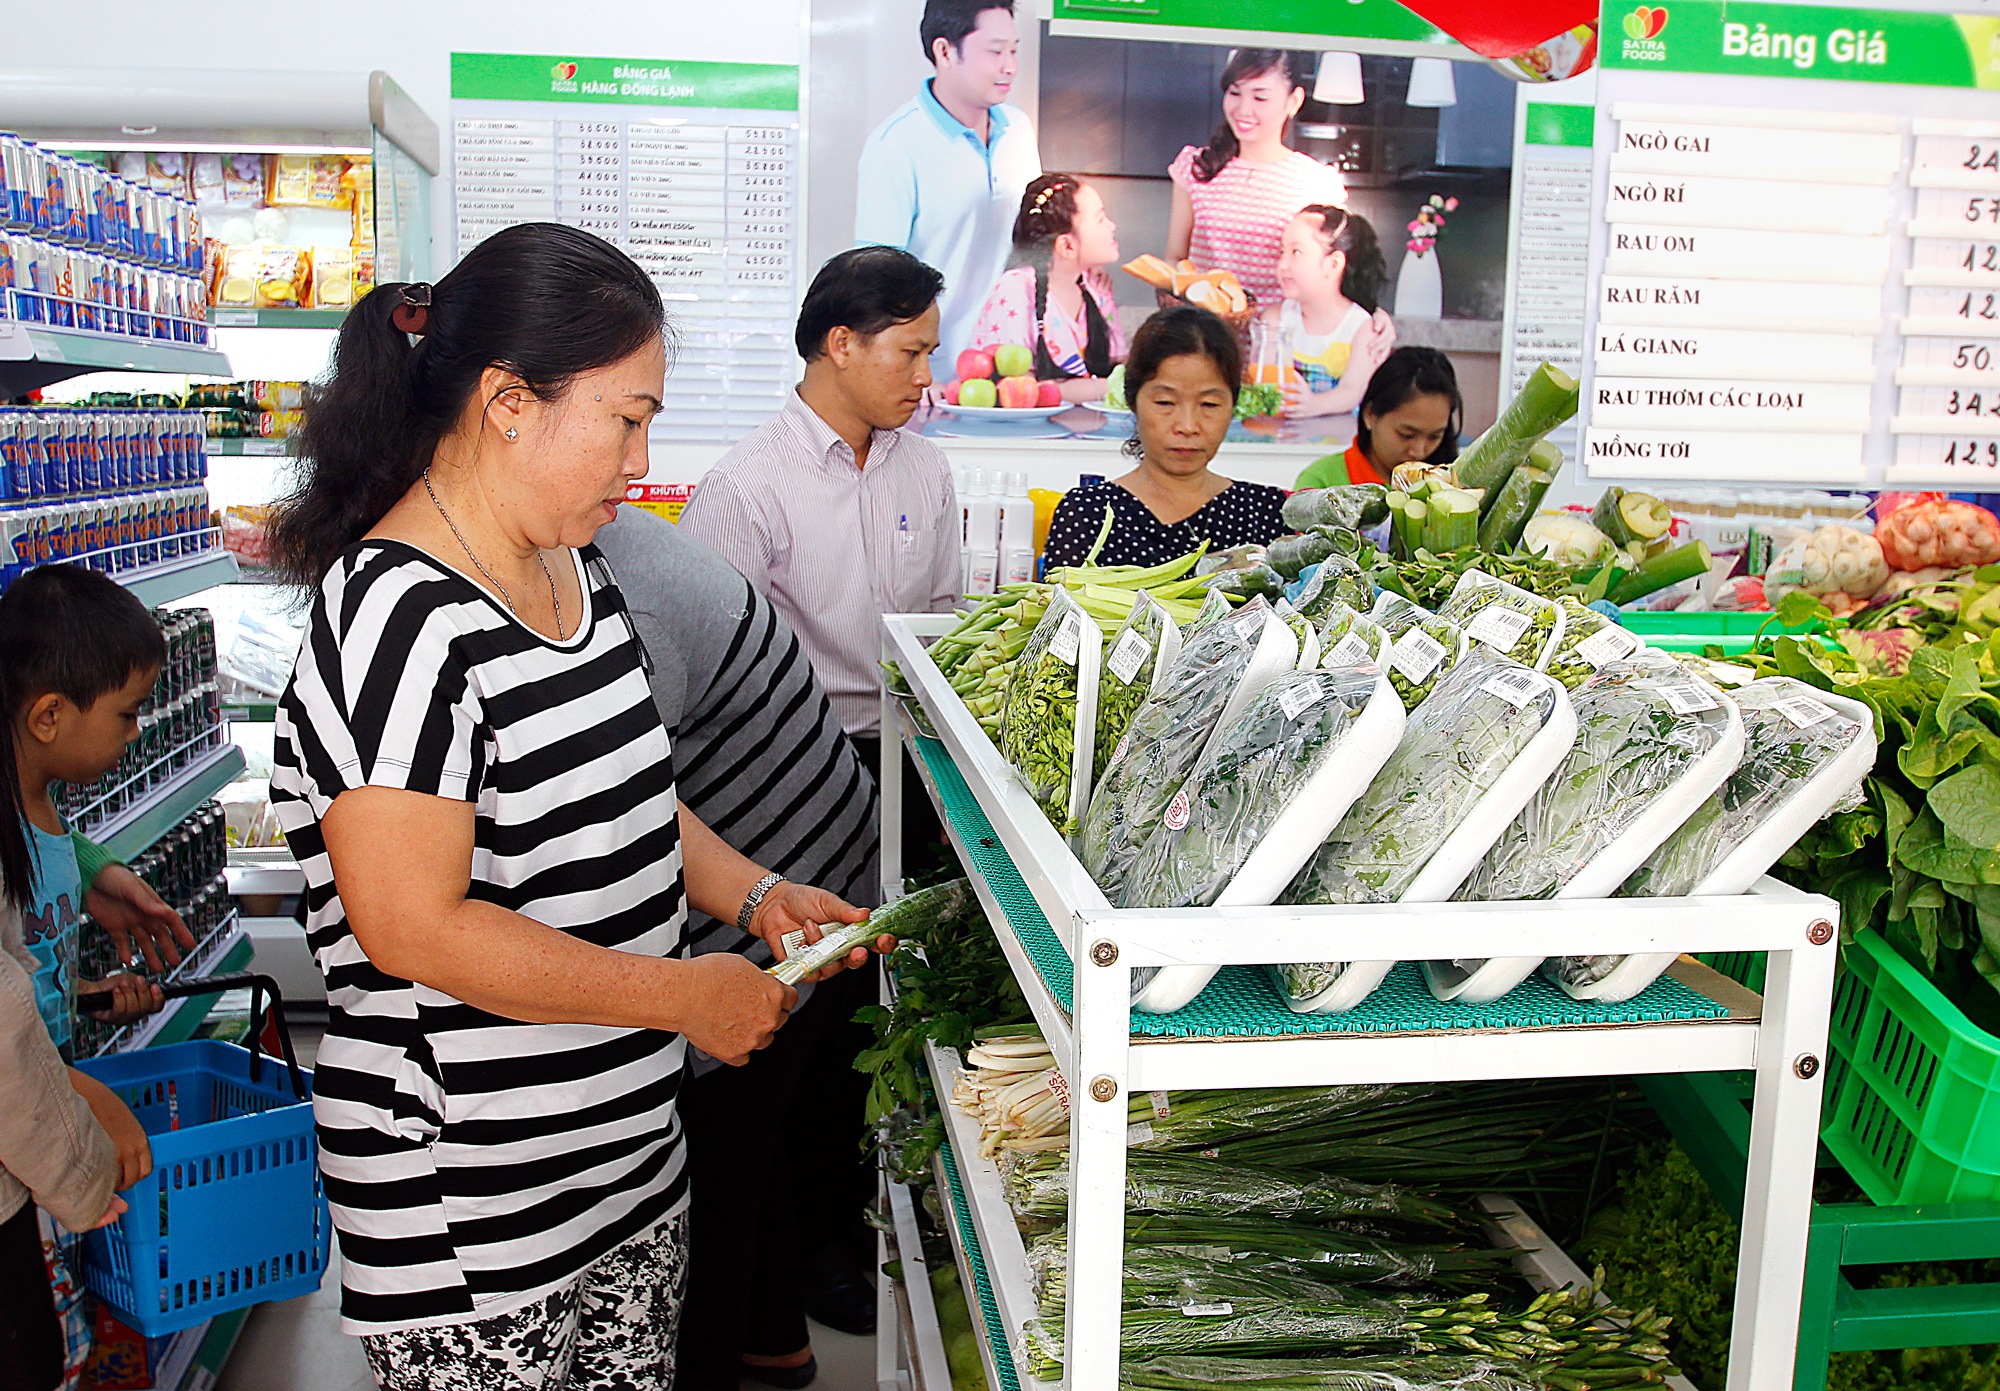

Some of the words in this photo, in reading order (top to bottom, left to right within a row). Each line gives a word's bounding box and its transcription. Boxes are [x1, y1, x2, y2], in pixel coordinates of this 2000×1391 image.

[1623, 39, 1665, 51] SATRA
[1623, 50, 1665, 61] FOODS
[1721, 21, 1816, 69] Bảng
[1827, 29, 1887, 65] Giá
[581, 81, 618, 95] HÀNG
[1624, 131, 1668, 150] NGÒ
[1674, 136, 1711, 153] GAI
[1614, 182, 1657, 202] NGÒ
[1663, 183, 1685, 203] RÍ
[1616, 234, 1658, 251] RAU
[1663, 236, 1695, 252] OM
[1607, 287, 1648, 304] RAU
[1654, 285, 1700, 305] RĂM
[1600, 333, 1626, 353] LÁ
[1633, 338, 1698, 355] GIANG
[1598, 389, 1640, 406] RAU
[1645, 388, 1704, 407] THƠM
[1709, 388, 1752, 408] CÁC
[1756, 392, 1804, 411] LOẠI
[1591, 434, 1651, 458] MỒNG
[1657, 441, 1690, 458] TƠI
[1048, 1077, 1070, 1112] SATRA
